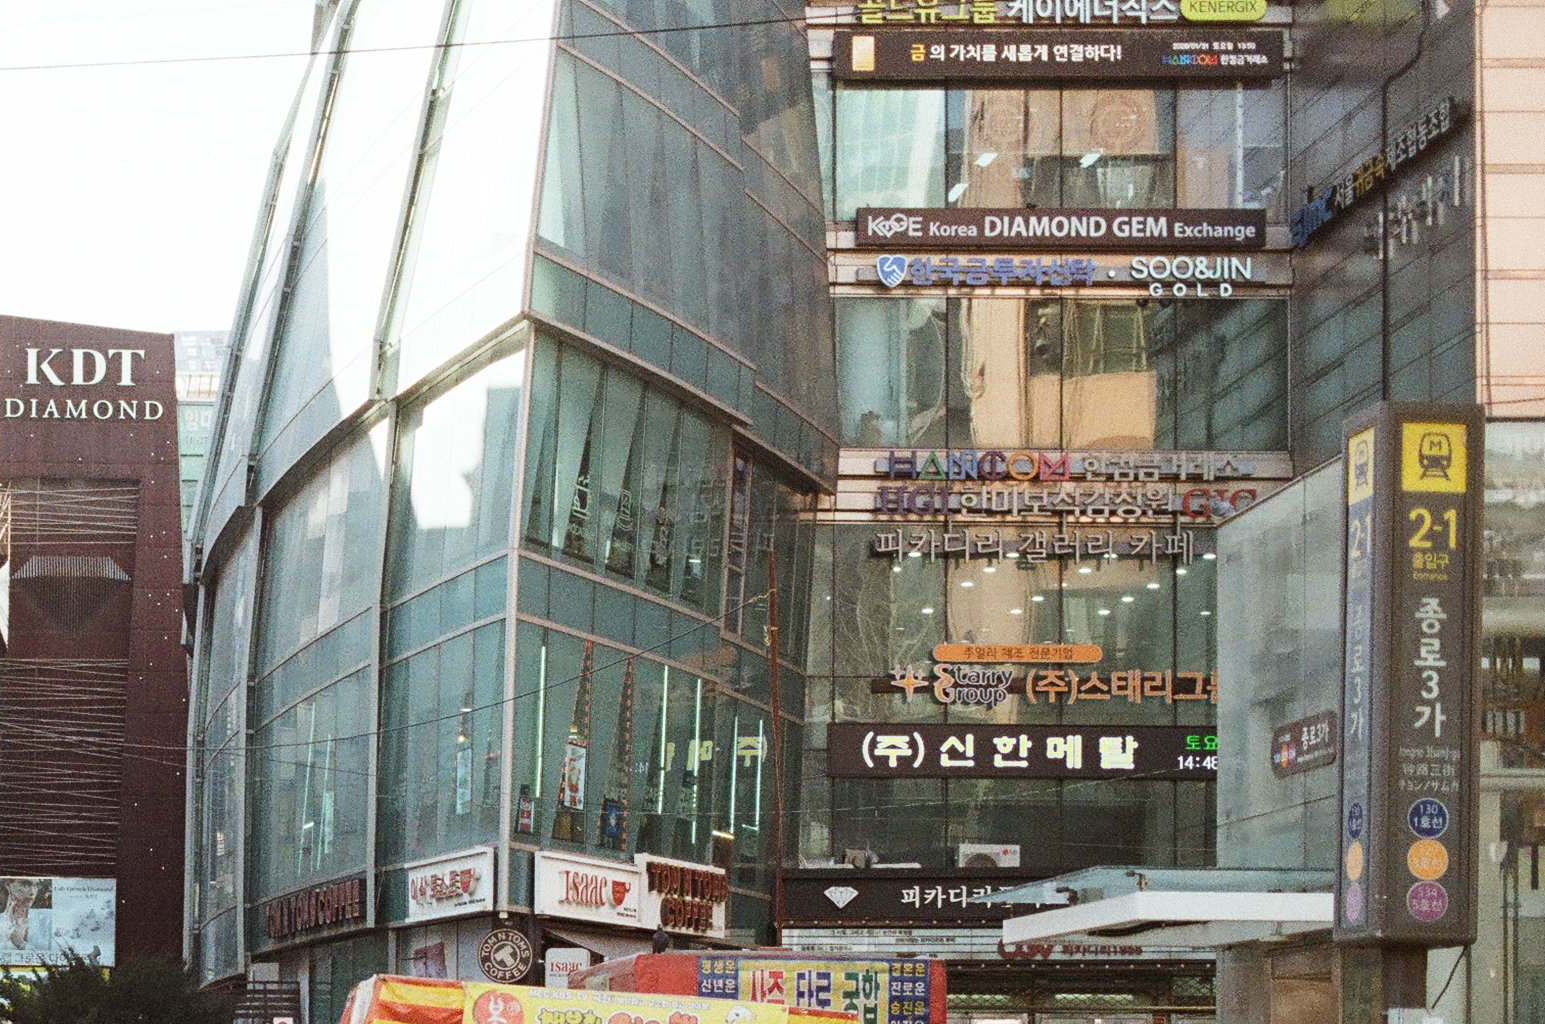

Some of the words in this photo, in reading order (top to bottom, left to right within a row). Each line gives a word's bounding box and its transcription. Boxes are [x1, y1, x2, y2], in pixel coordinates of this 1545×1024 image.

[949, 43, 999, 62] 가치를
[1001, 43, 1050, 62] 새롭게
[1053, 42, 1123, 62] 연결하다!
[929, 222, 977, 238] Korea
[984, 216, 1106, 238] DIAMOND
[1112, 216, 1168, 238] GEM
[1174, 221, 1256, 241] Exchange
[910, 257, 1096, 287] 한국금투자신탁
[1130, 256, 1252, 280] SOO&JIN
[1149, 283, 1234, 297] GOLD
[25, 348, 146, 387] KDT
[5, 397, 164, 421] DIAMOND
[888, 450, 1071, 481] HANCOM
[874, 485, 953, 515] HGI
[960, 484, 1175, 519] 한미보석감정원
[1408, 507, 1457, 549] 2-1
[874, 529, 1005, 564] 피카디리
[1018, 529, 1115, 565] 갤러리
[1130, 529, 1195, 565] 카페
[1412, 552, 1449, 569] 출입구
[964, 646, 997, 659] 주얼리
[1002, 646, 1024, 659] 제조
[1029, 645, 1074, 659] 전문기업
[933, 663, 1013, 692] Starry
[1414, 597, 1447, 738] 종로3가
[936, 683, 1010, 706] Group
[1413, 816, 1443, 829] 1호선
[564, 870, 608, 907] Isaac
[651, 862, 681, 894] TOM
[694, 869, 729, 902] TOMS
[664, 897, 714, 931] COFFEE
[481, 936, 498, 957] TOM
[507, 932, 530, 959] TOMS
[484, 962, 527, 980] COFFEE
[701, 959, 736, 974] 평생운
[701, 978, 736, 994] 신년운
[891, 981, 926, 997] 진로운
[891, 1000, 926, 1016] 승진운
